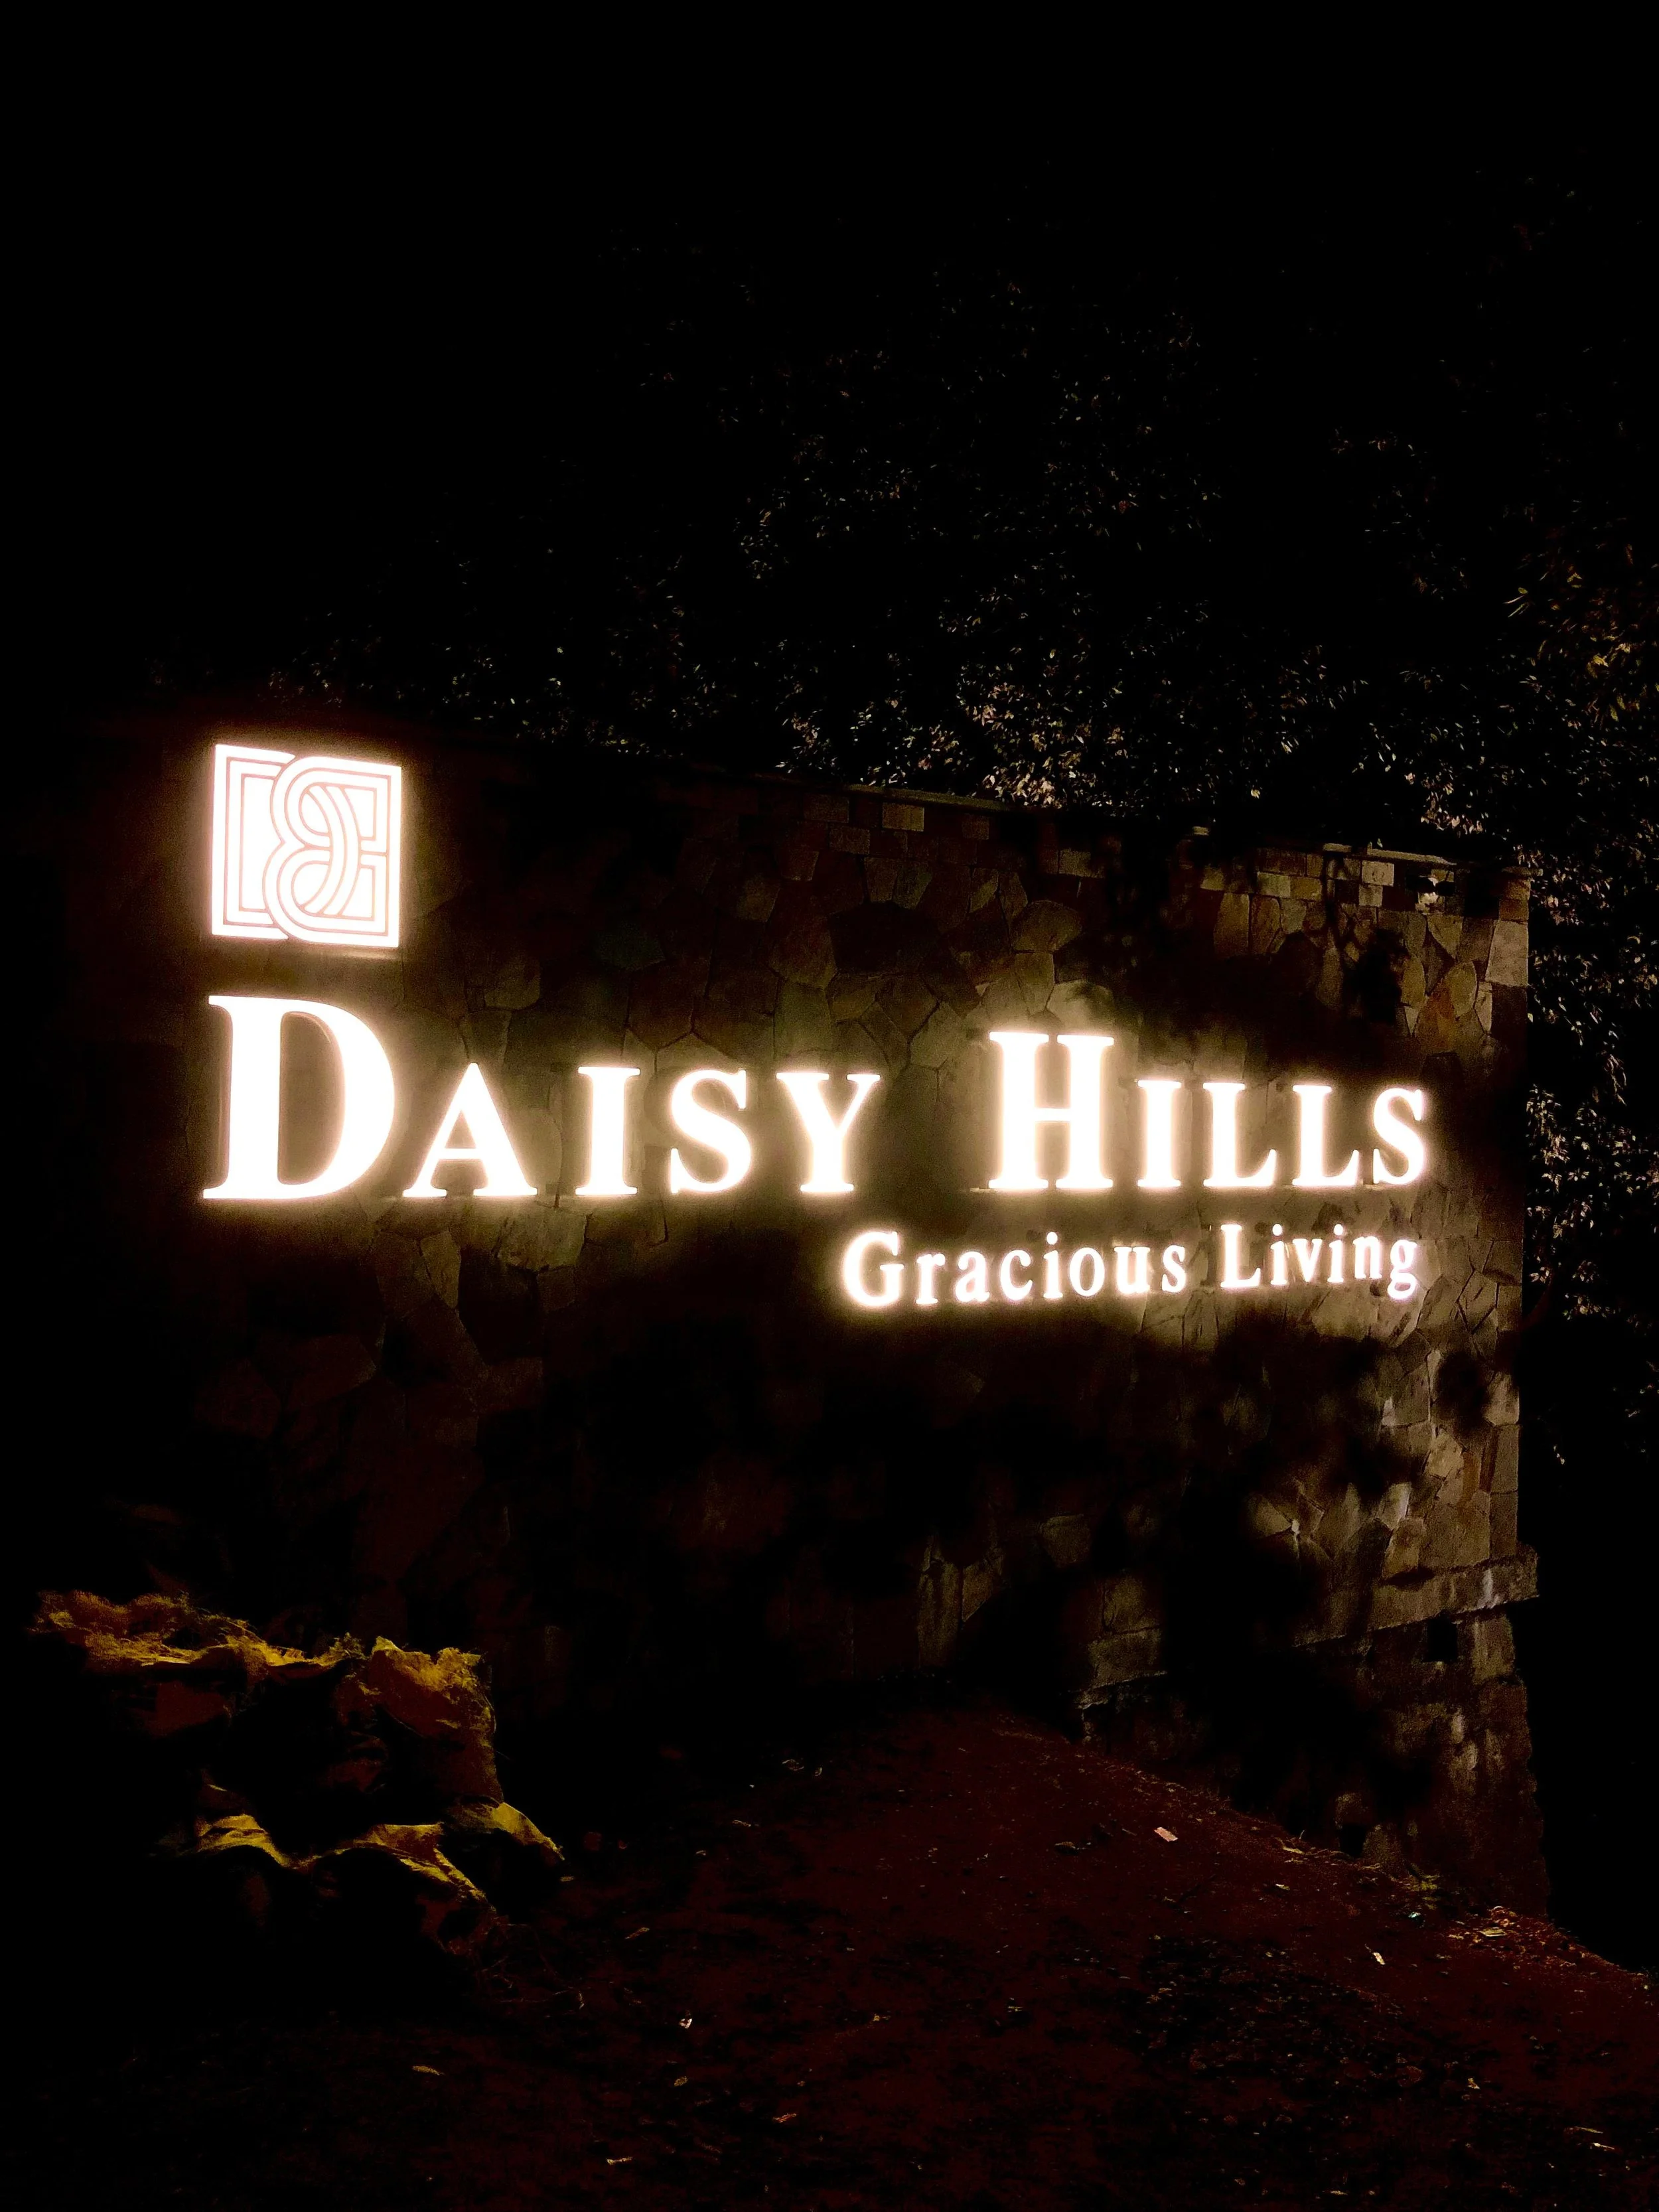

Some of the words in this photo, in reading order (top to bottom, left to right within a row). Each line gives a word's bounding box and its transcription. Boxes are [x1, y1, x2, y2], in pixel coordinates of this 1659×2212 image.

[203, 994, 881, 1201] DAISY
[987, 1031, 1427, 1193] HILLS
[843, 1230, 1187, 1307] Gracious
[1220, 1223, 1419, 1301] Living
